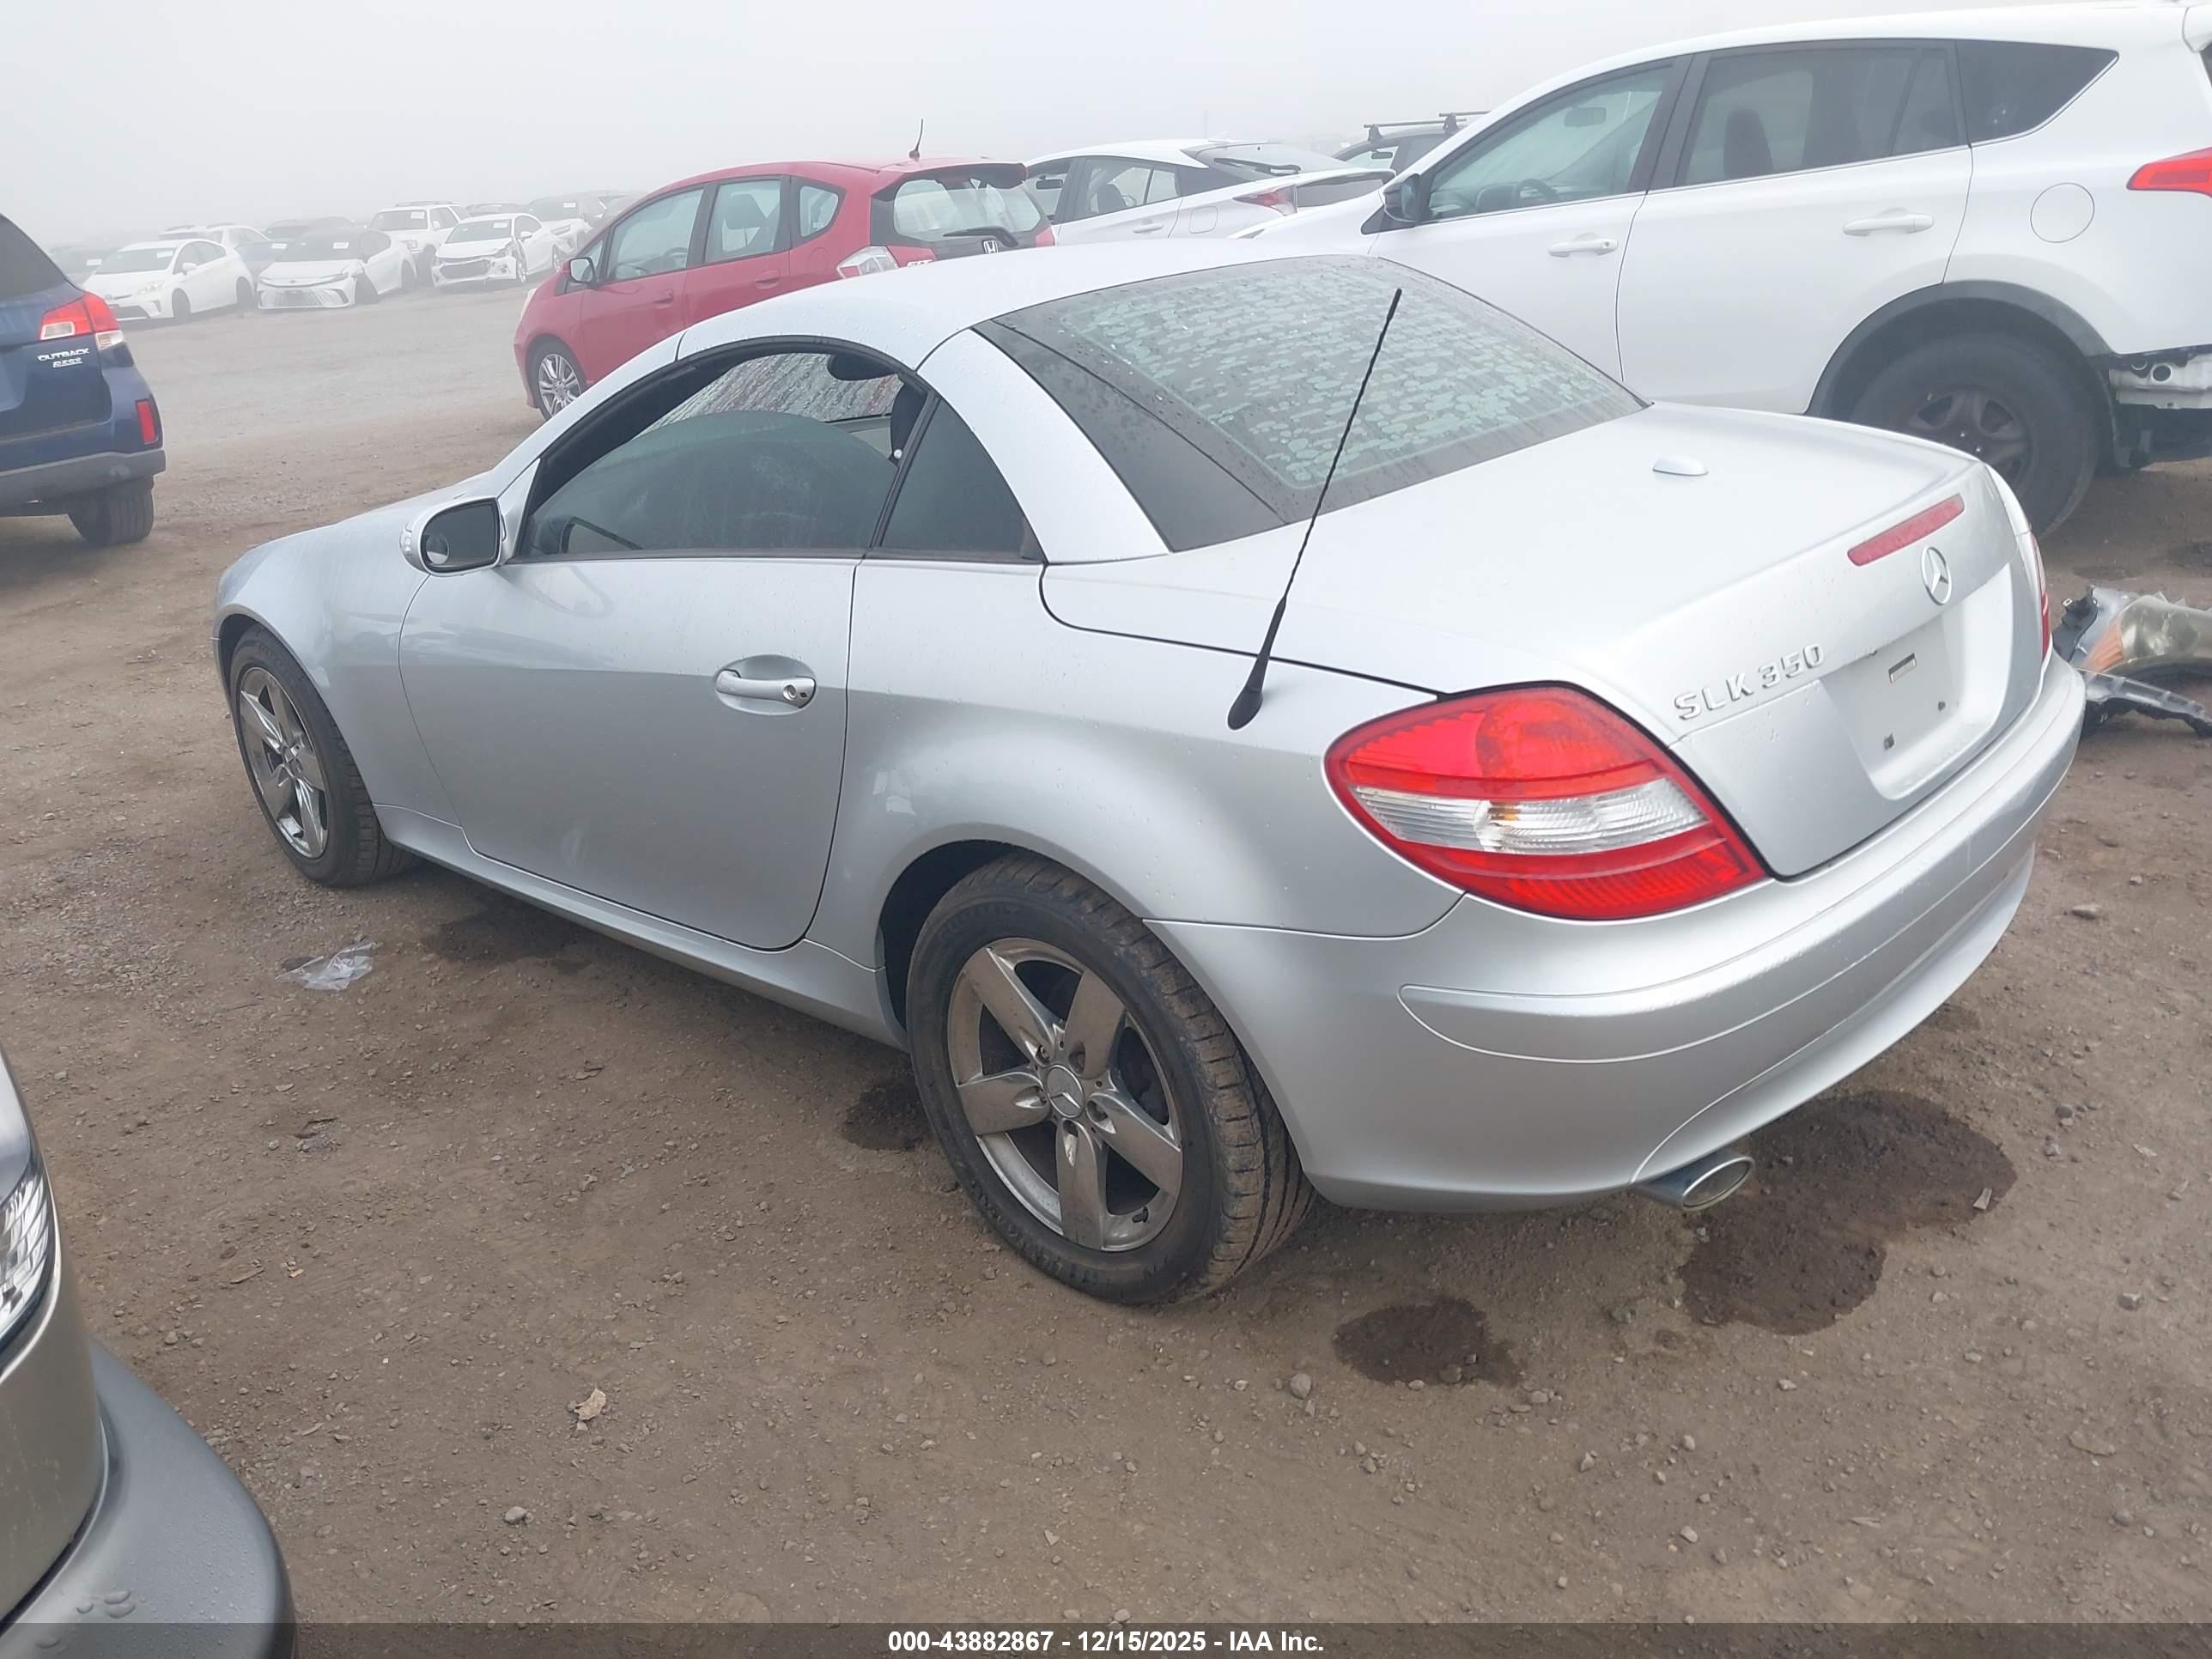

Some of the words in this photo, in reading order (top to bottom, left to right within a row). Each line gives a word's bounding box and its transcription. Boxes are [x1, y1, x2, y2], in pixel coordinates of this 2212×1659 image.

[37, 348, 90, 362] OUTBACK
[1674, 672, 1753, 721] SLK
[1757, 643, 1827, 690] 350
